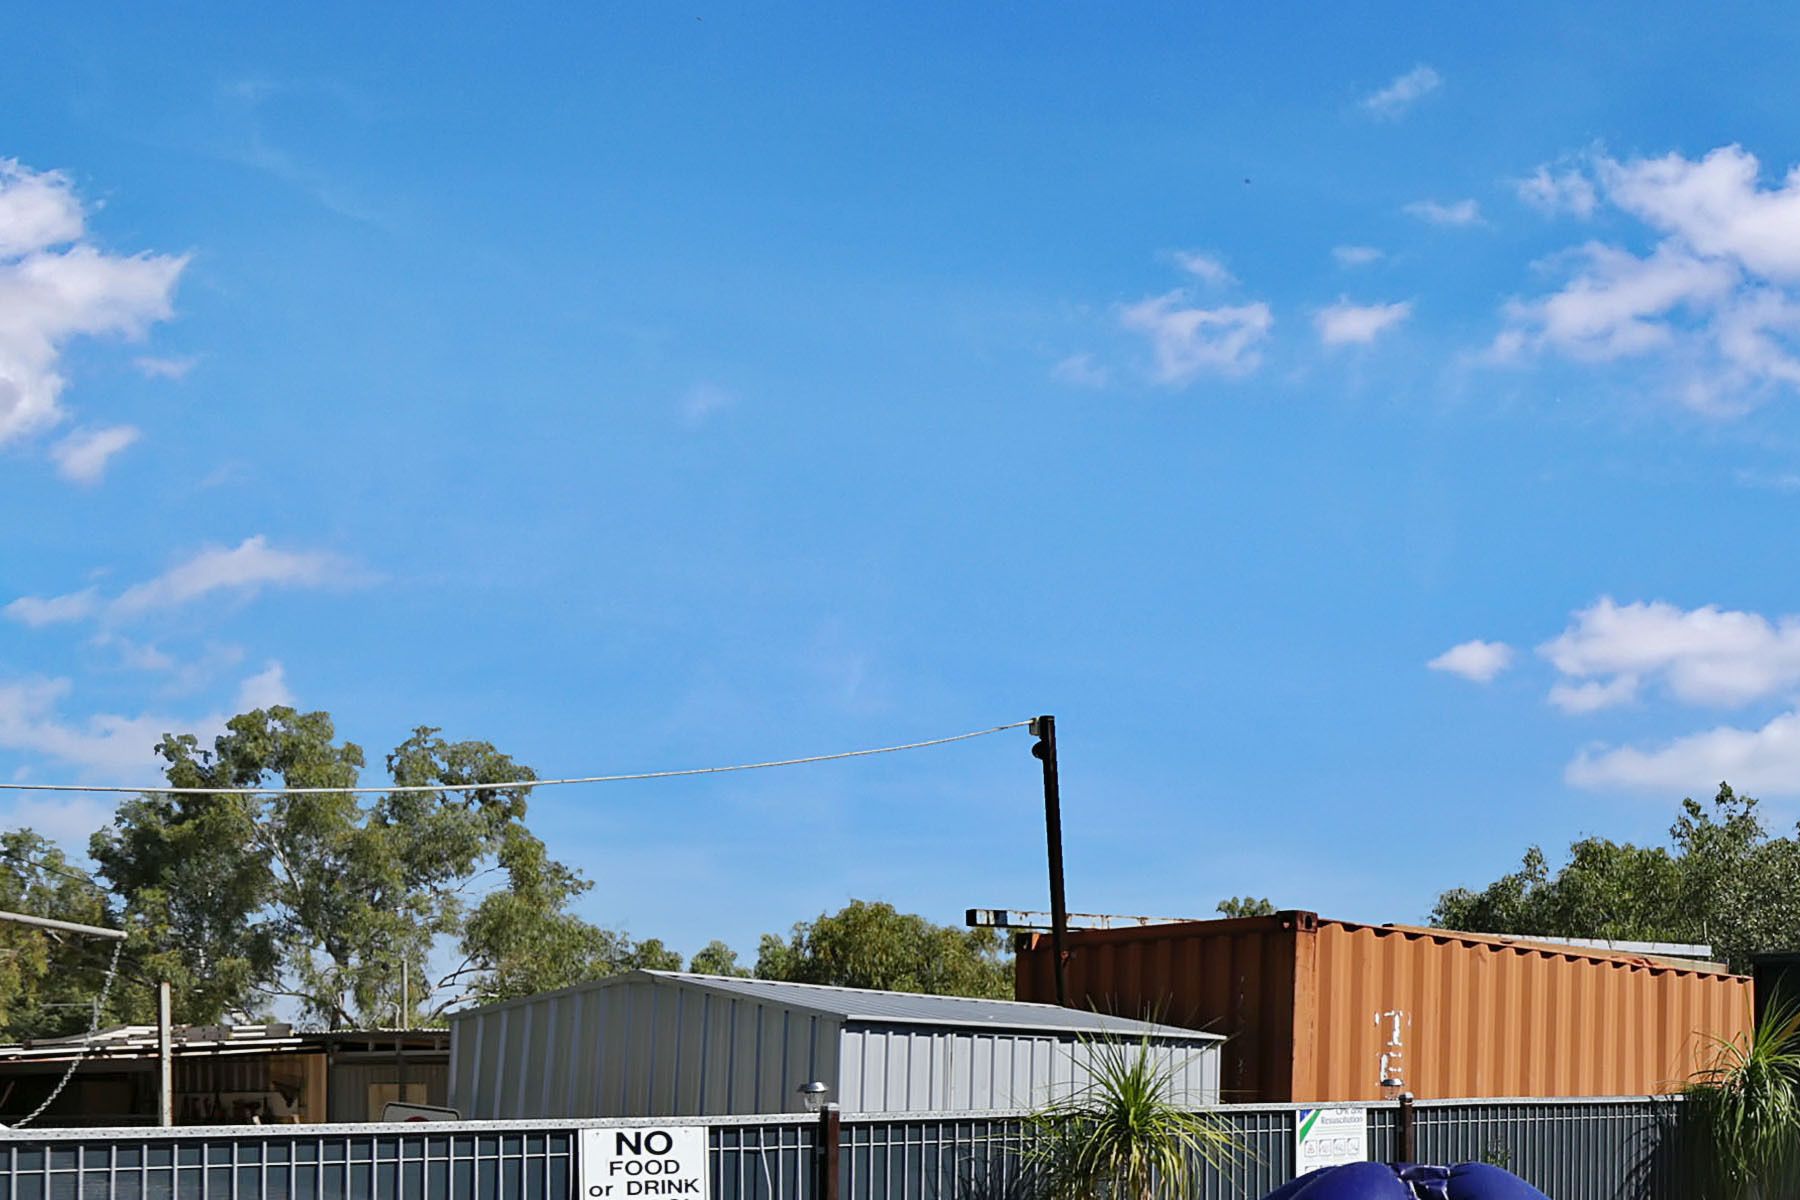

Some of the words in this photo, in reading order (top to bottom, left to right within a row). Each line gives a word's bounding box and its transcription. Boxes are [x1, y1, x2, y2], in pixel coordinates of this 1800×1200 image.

[616, 1130, 673, 1156] NO
[609, 1159, 680, 1176] FOOD
[589, 1185, 614, 1197] or
[627, 1178, 700, 1196] DRINK
